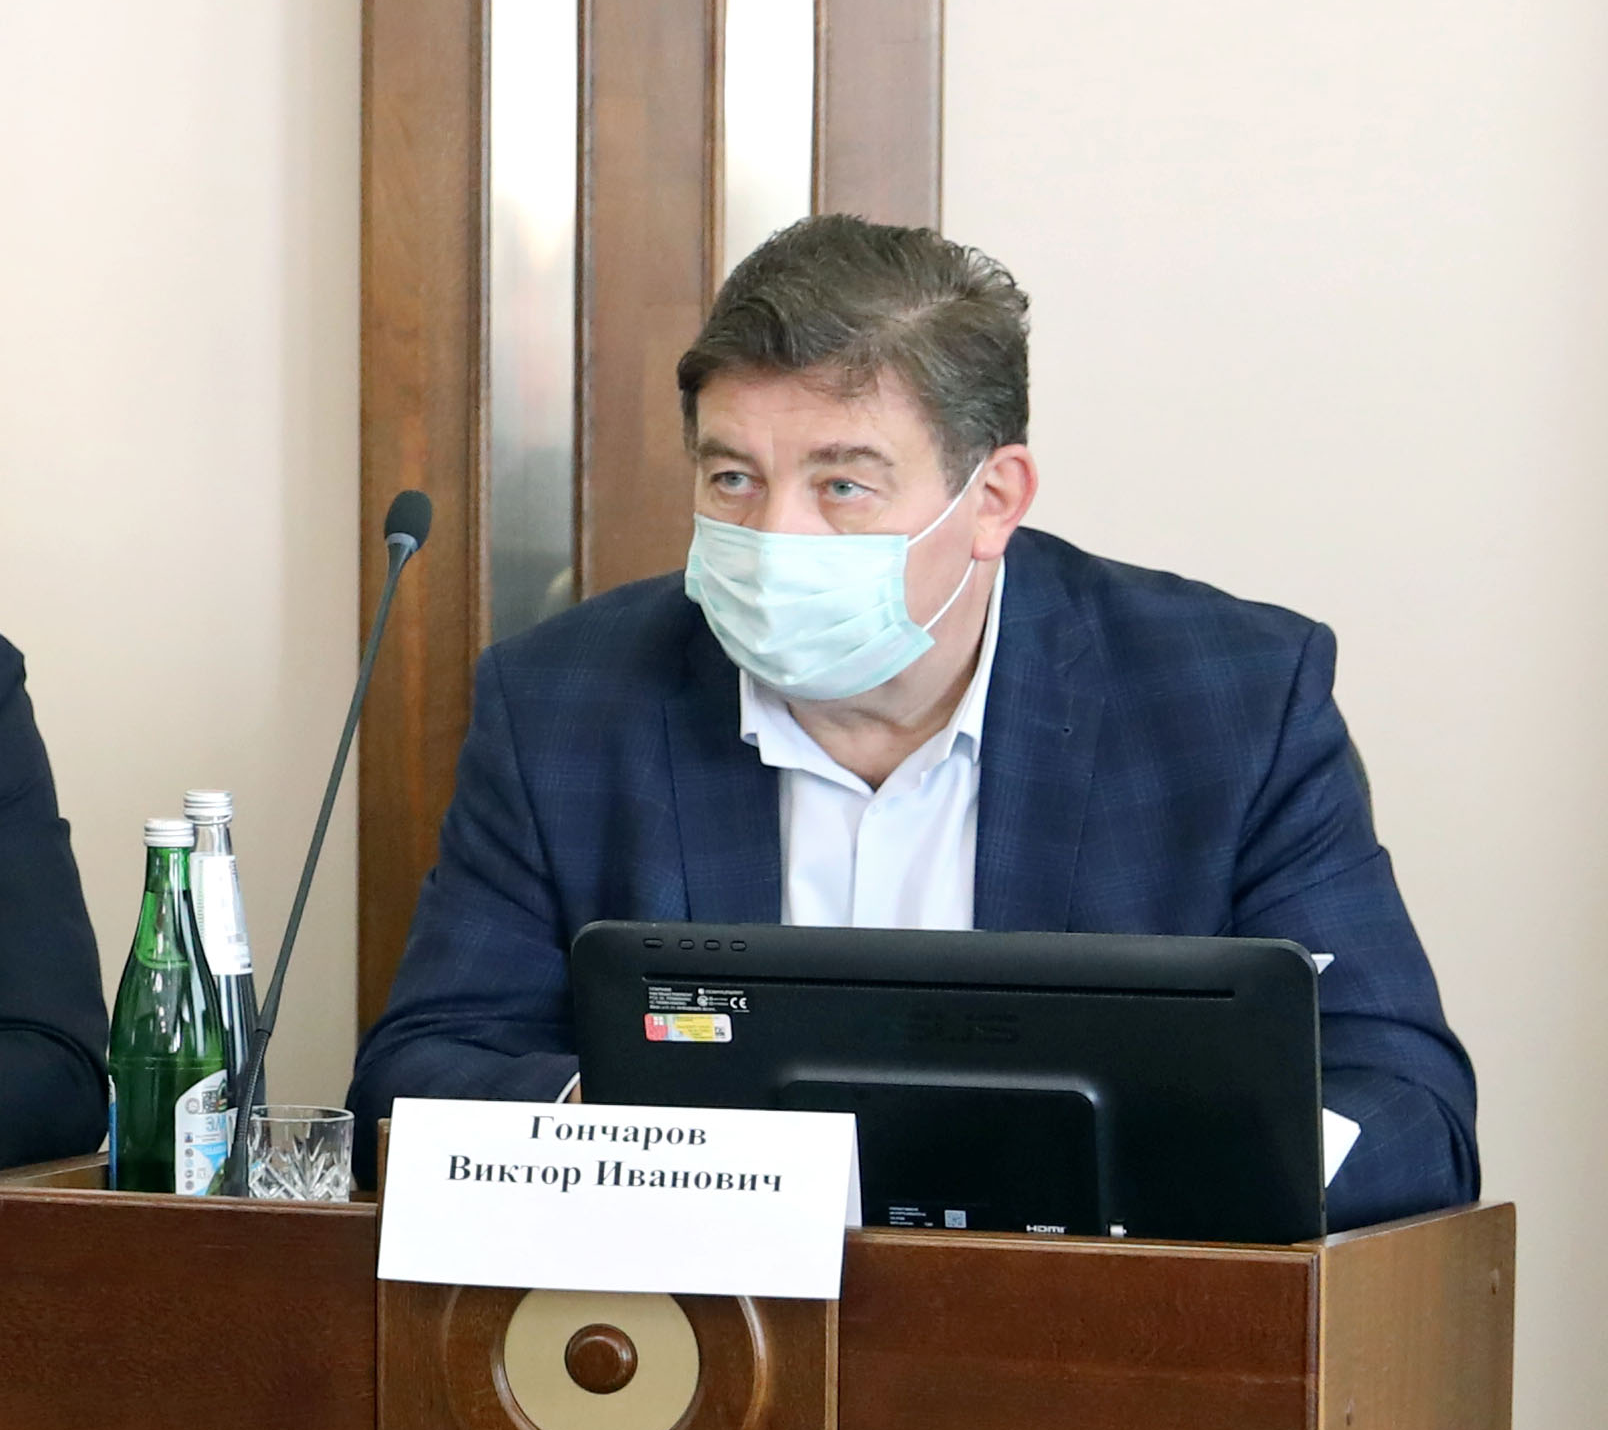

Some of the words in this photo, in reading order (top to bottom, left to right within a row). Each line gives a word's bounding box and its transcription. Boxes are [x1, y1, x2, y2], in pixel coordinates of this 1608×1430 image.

[531, 1115, 707, 1151] Гончаров
[448, 1155, 582, 1193] Виктор
[596, 1160, 783, 1193] Иванович
